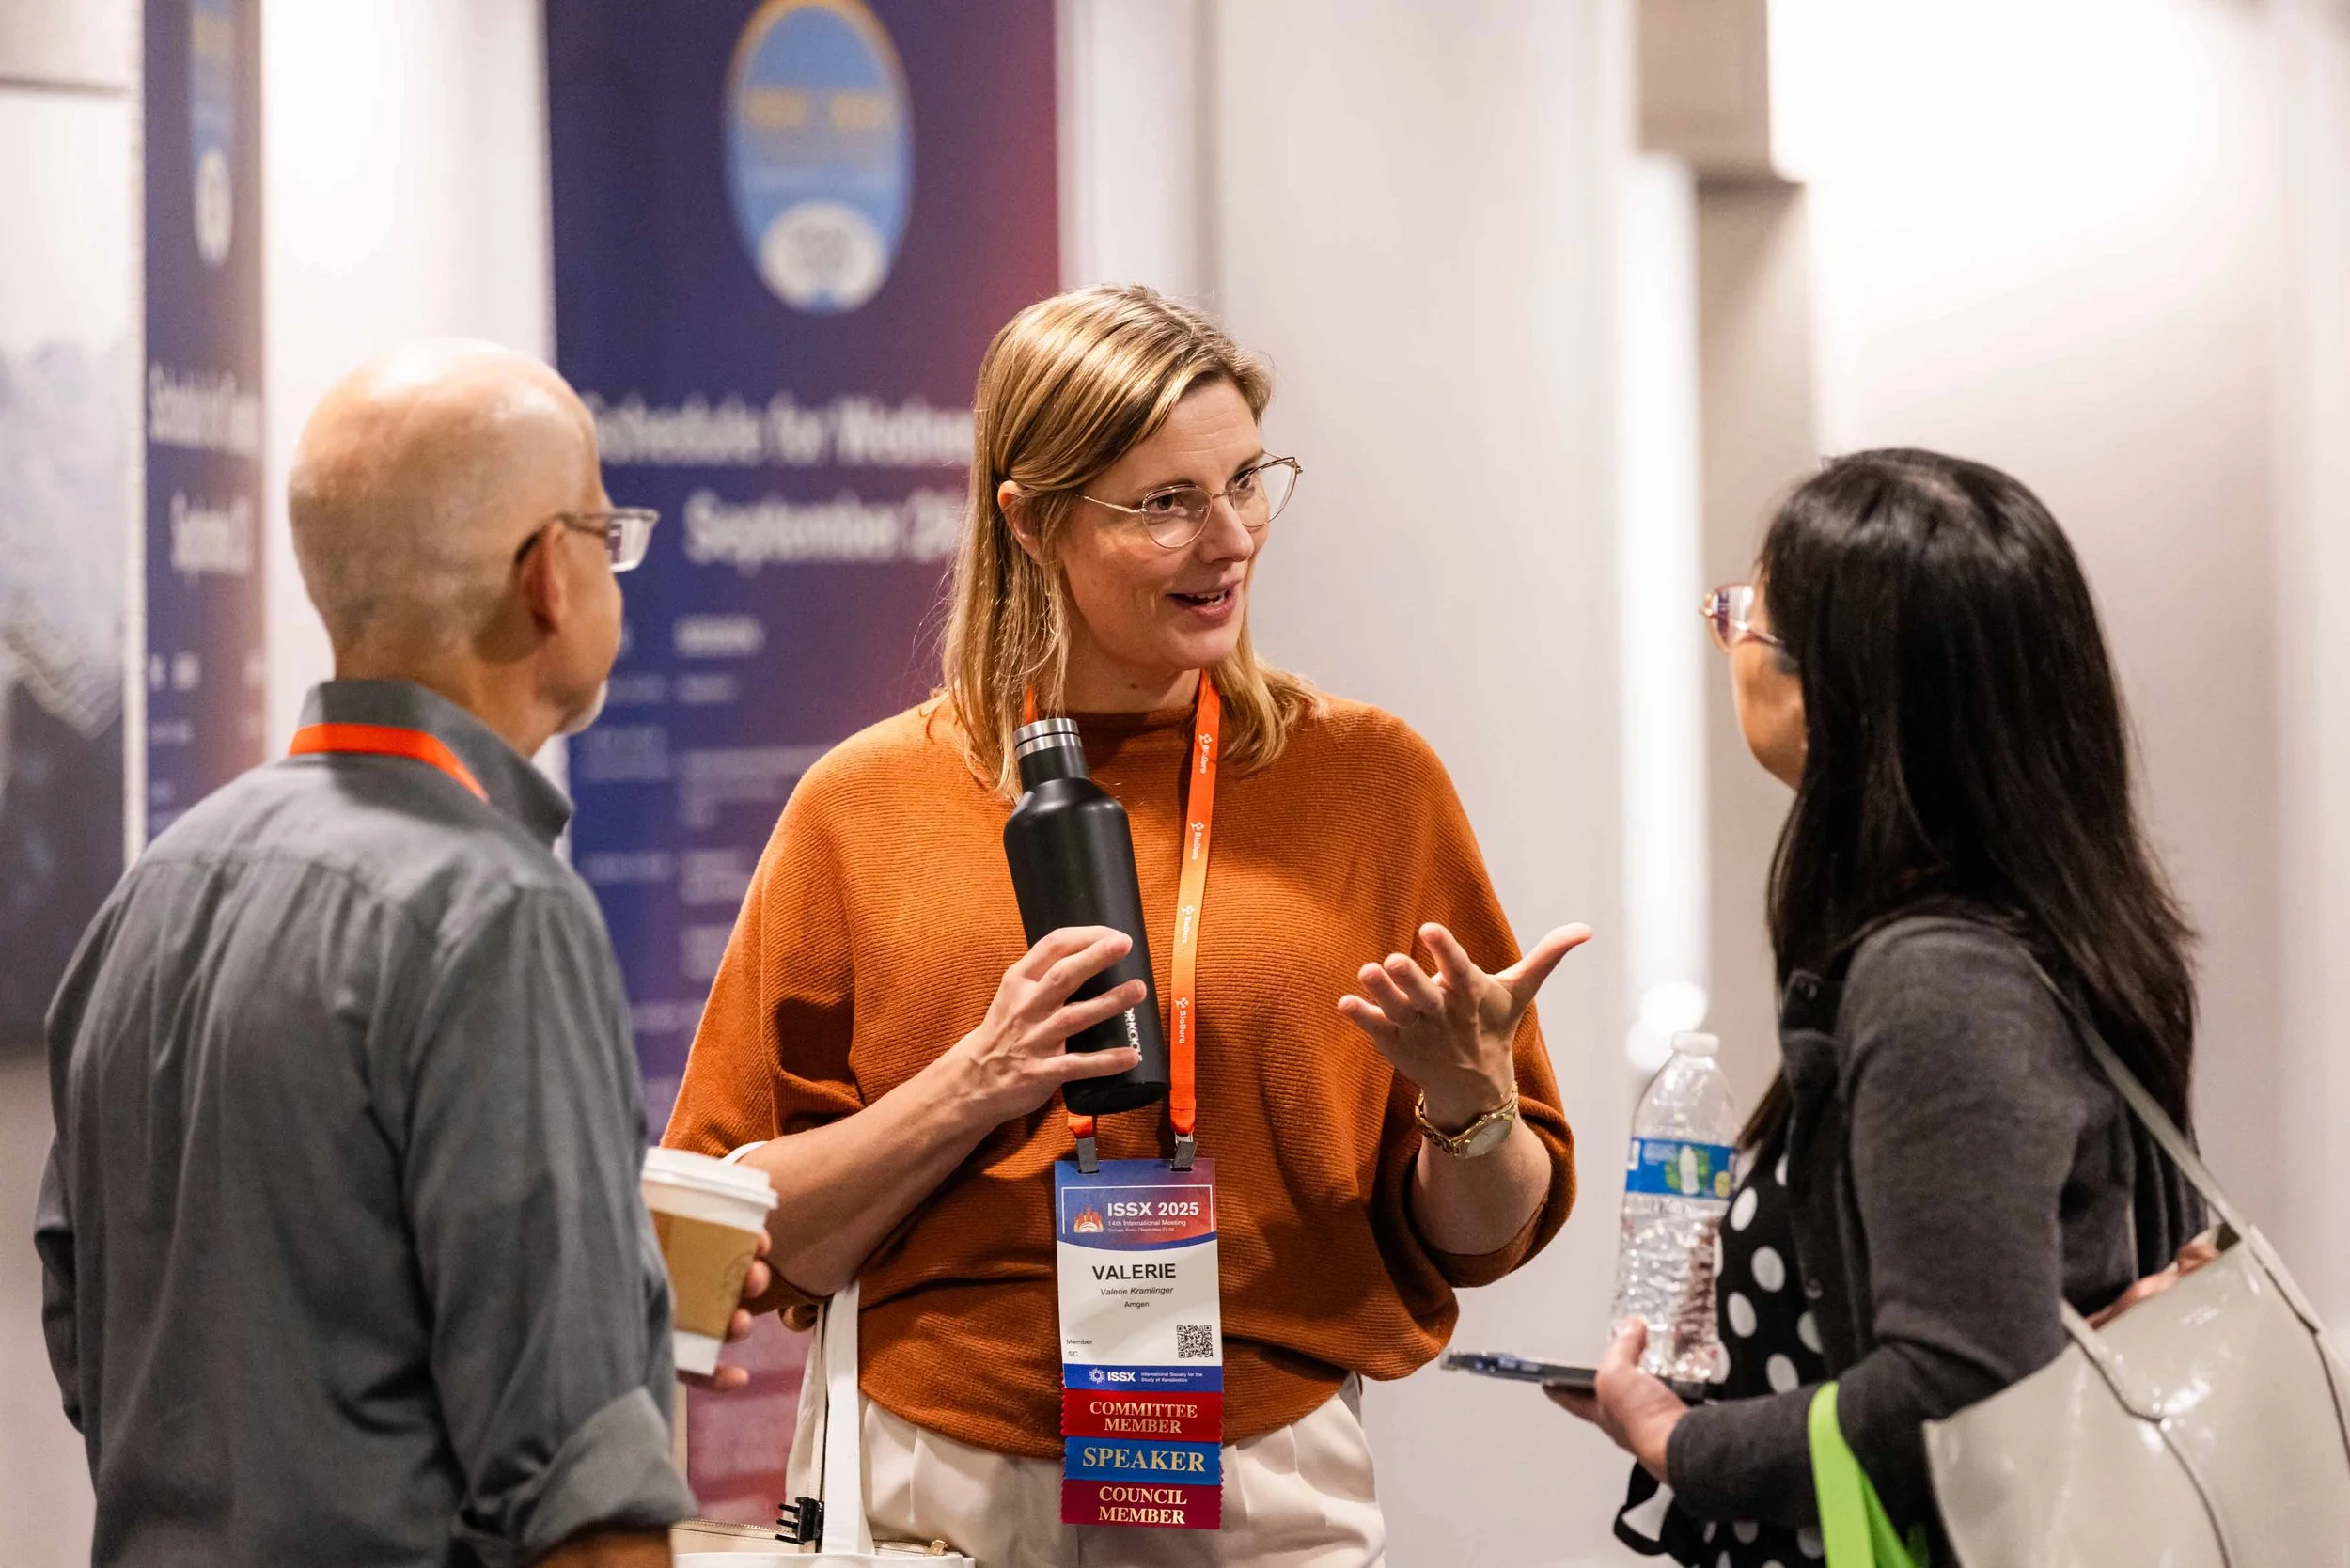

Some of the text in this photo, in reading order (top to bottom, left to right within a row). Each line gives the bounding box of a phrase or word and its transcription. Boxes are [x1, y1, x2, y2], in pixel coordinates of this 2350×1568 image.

[582, 391, 761, 466] chedule
[1192, 831, 1202, 860] BioDuro
[1179, 1010, 1187, 1044] BioDuro
[1107, 1201, 1200, 1217] ISSX 2025
[1161, 1218, 1187, 1228] Meeting
[1092, 1263, 1177, 1280] VALERIE
[1100, 1286, 1174, 1296] Valerie Kramlinger
[1124, 1300, 1150, 1309] Amgen
[1107, 1372, 1136, 1382] ISSX
[1089, 1401, 1198, 1419] COMMITTEE
[1104, 1418, 1182, 1435] MEMBER
[1082, 1446, 1206, 1473] SPEAKER
[1099, 1485, 1188, 1506] COUNCIL
[1098, 1506, 1185, 1525] MEMBER
